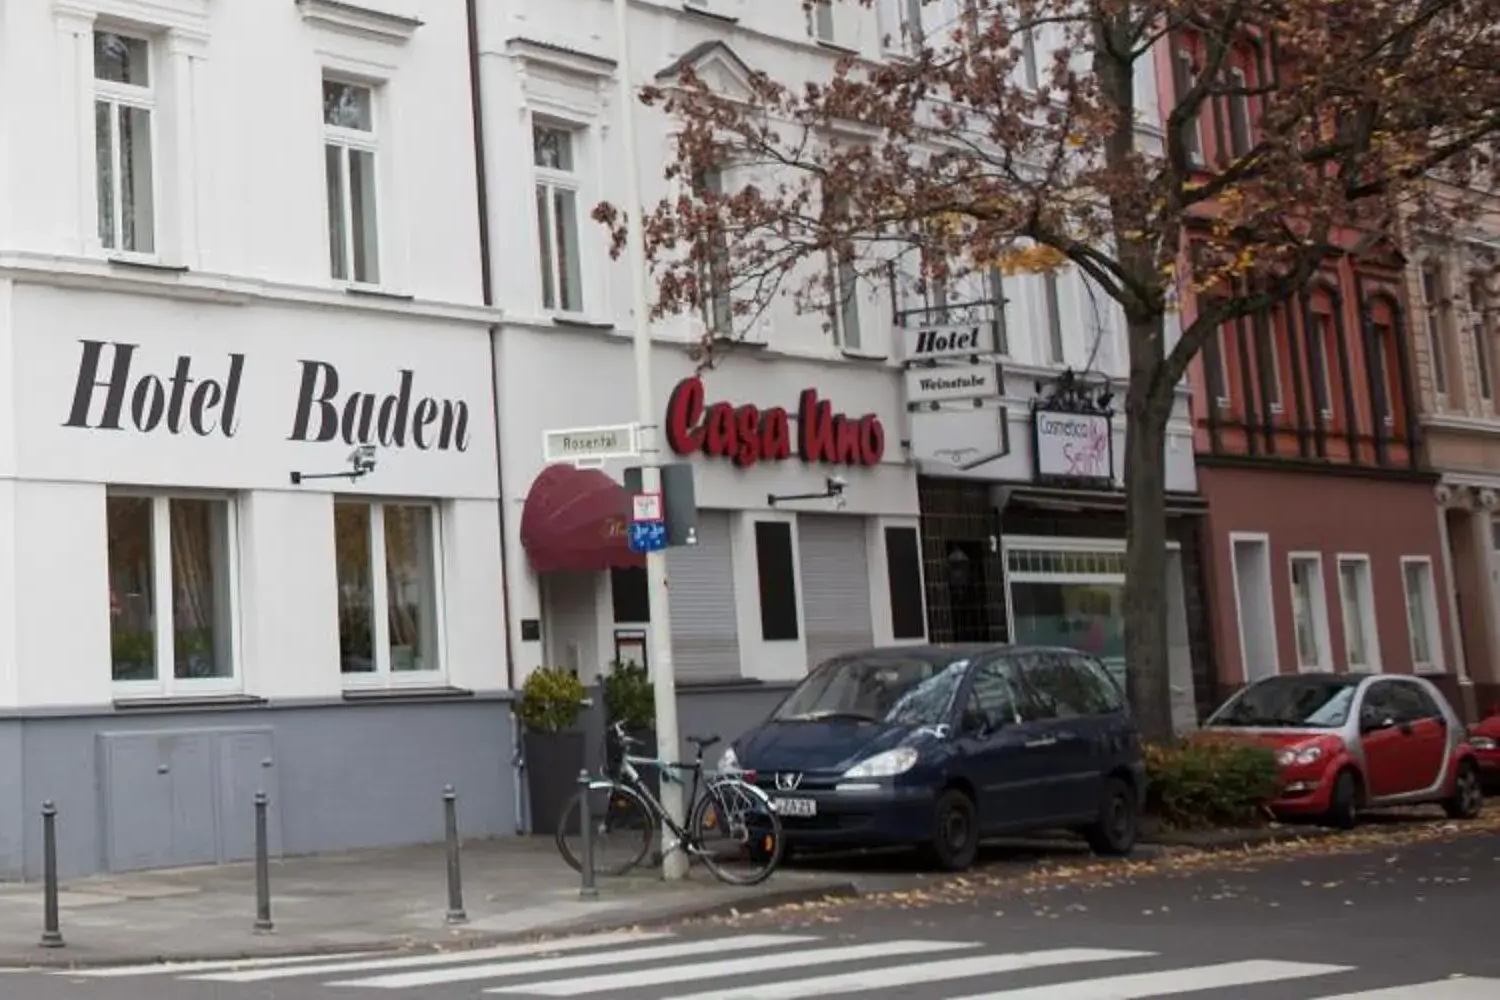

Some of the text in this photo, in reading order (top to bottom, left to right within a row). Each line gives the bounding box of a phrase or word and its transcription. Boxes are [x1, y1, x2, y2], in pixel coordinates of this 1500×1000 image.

[915, 327, 979, 353] Hotel
[61, 339, 471, 452] Hotel Baden
[919, 374, 985, 393] Weinstube
[666, 374, 885, 468] Casa Uno
[562, 431, 617, 452] Rosental
